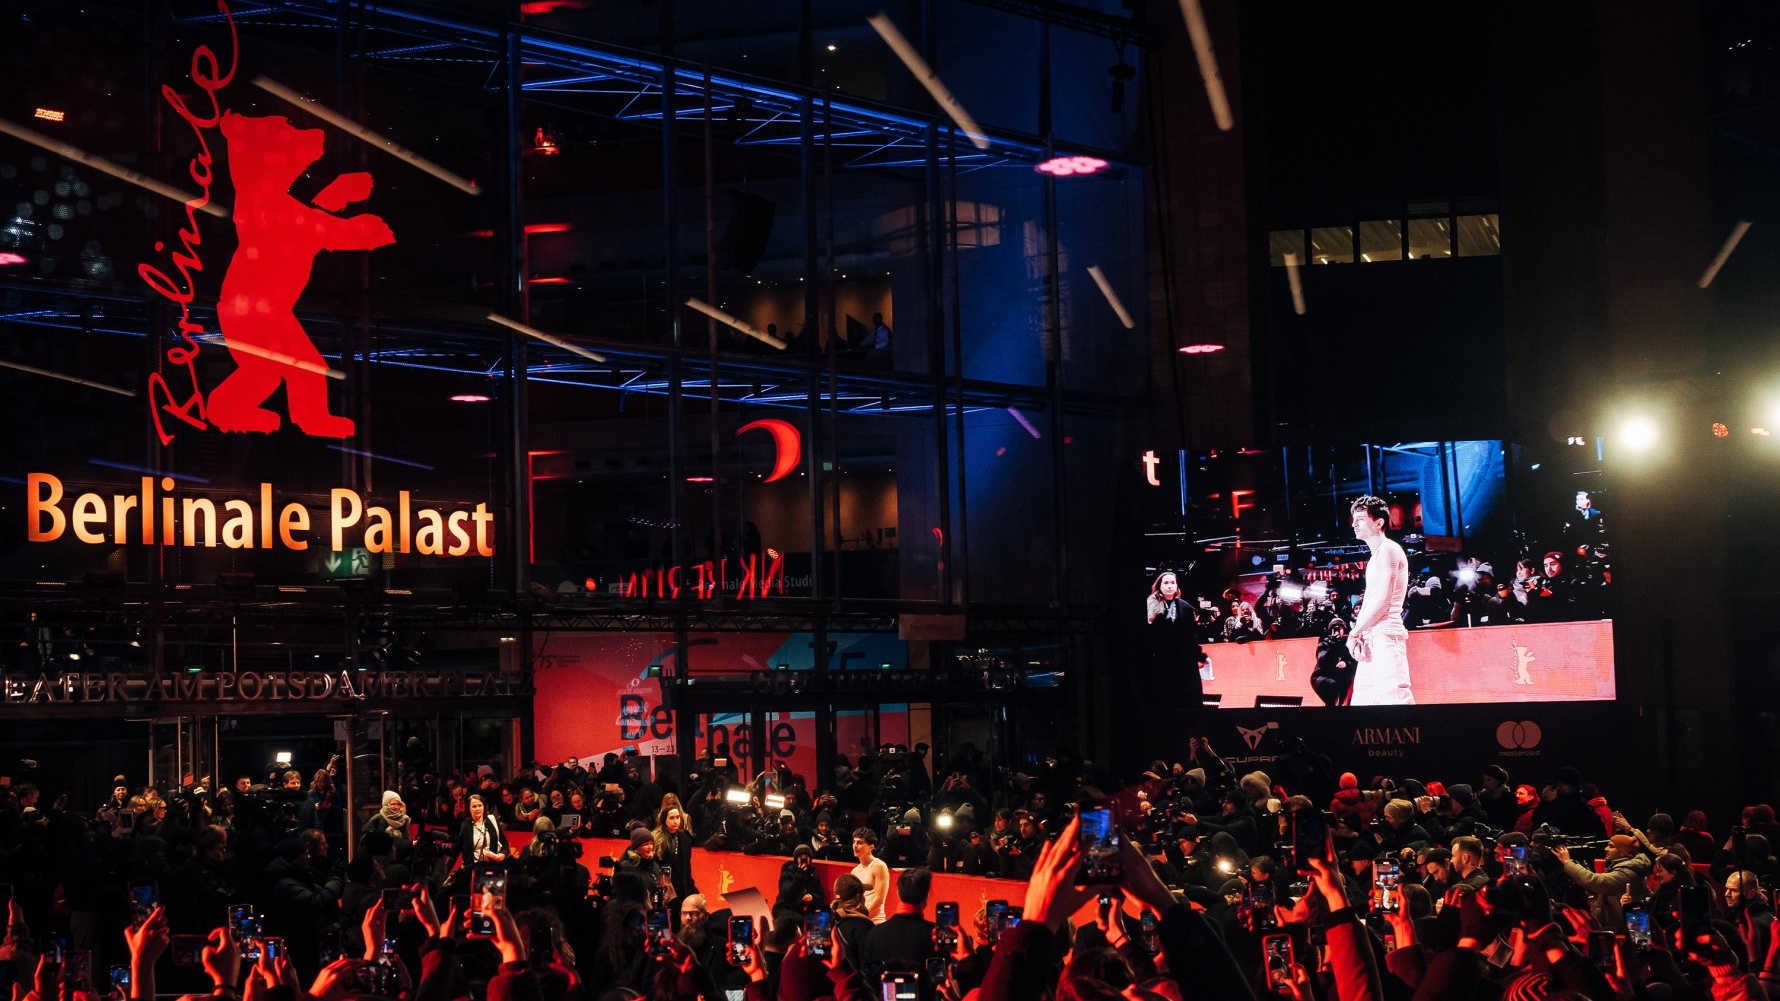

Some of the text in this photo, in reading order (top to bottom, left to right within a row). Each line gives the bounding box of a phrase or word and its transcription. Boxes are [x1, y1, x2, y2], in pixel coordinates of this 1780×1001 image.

[139, 0, 239, 445] Berlinale
[27, 472, 495, 558] Berlinale Palast
[147, 671, 206, 701] AM
[214, 669, 430, 701] POTSDAMER
[1351, 726, 1421, 746] ARMANI
[1368, 748, 1404, 758] beauty
